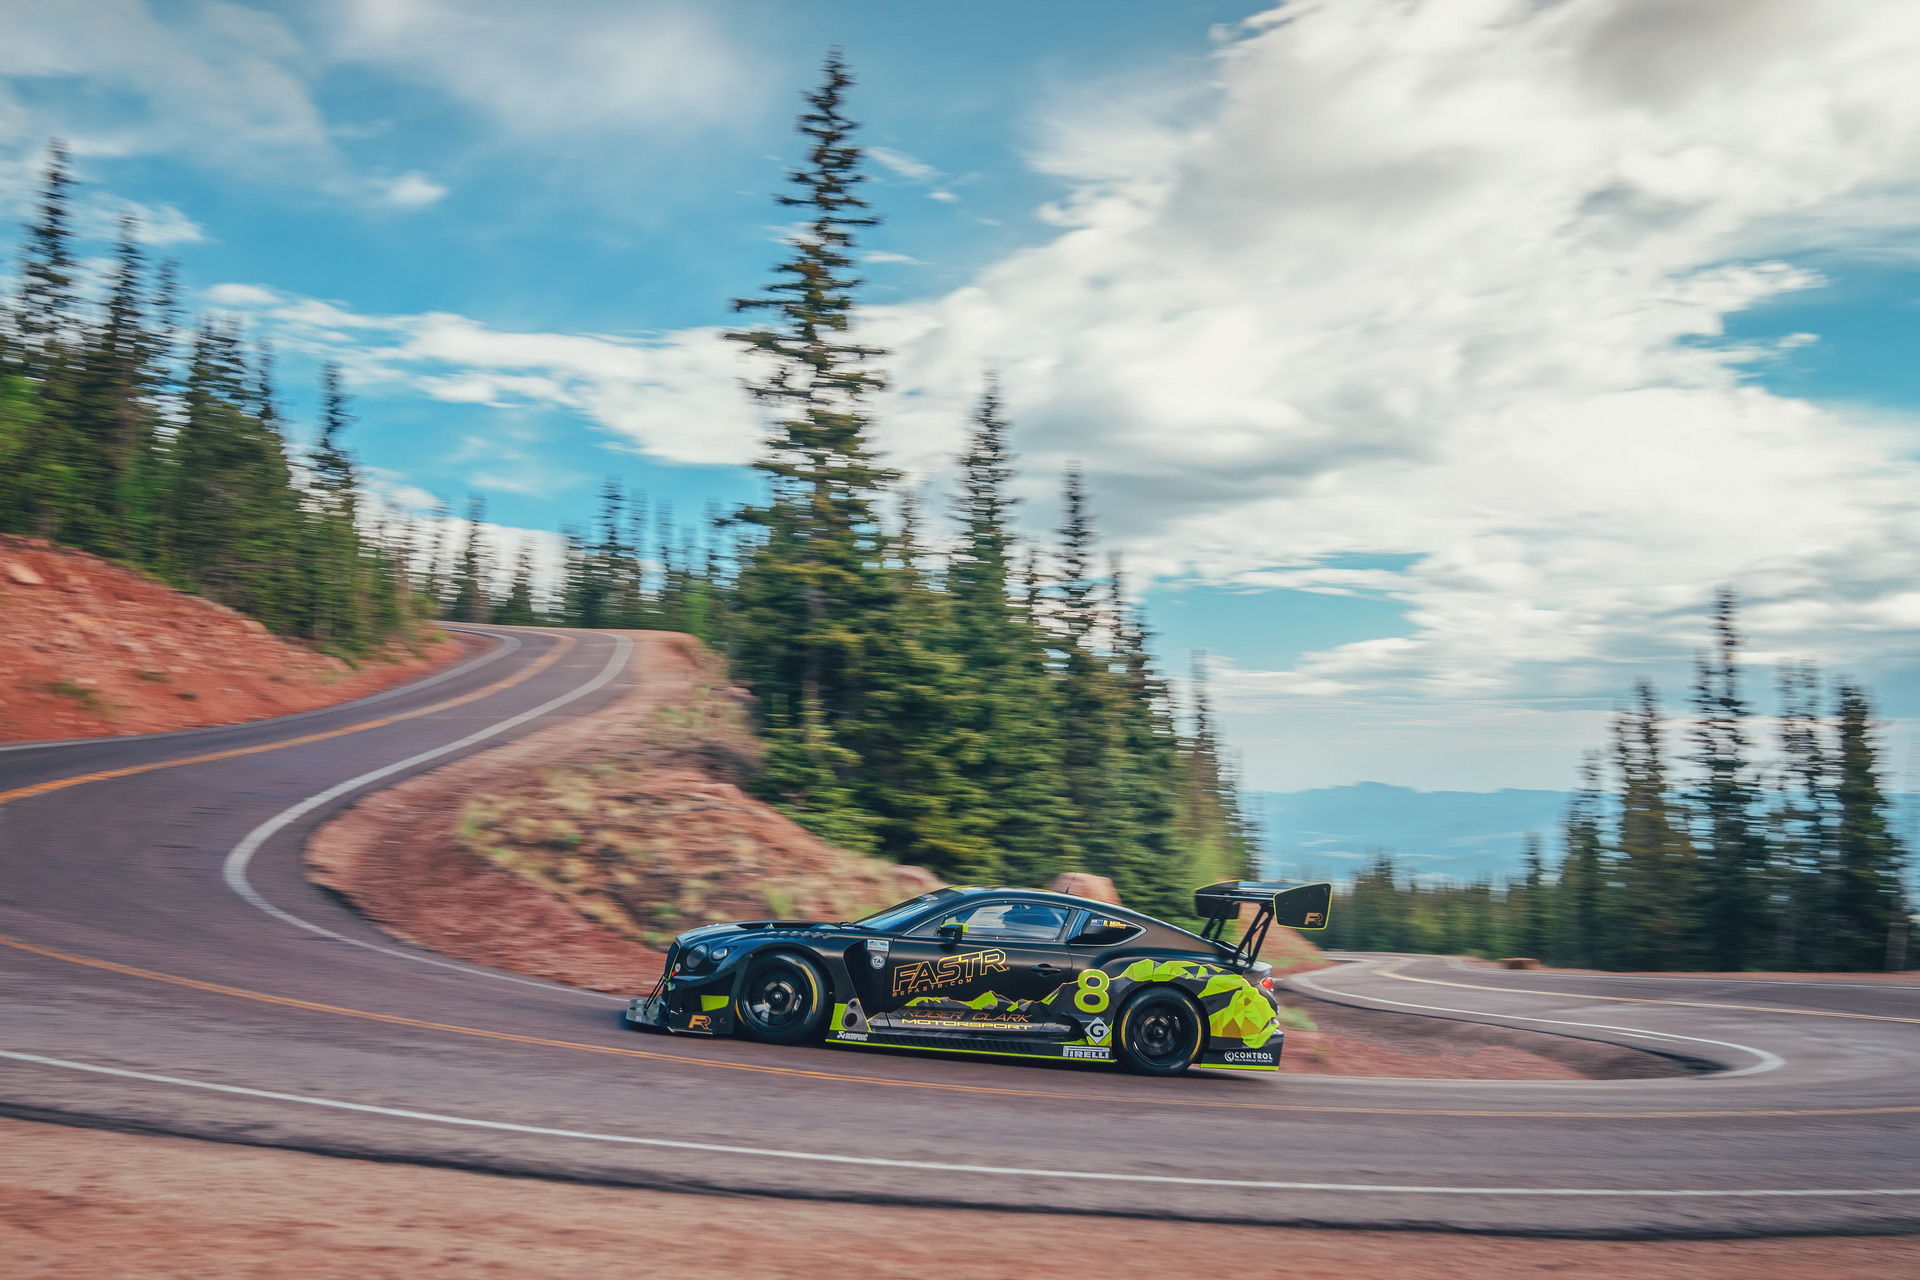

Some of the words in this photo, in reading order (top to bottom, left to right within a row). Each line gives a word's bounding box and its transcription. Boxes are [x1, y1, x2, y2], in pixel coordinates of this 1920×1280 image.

[892, 978, 972, 997] BEFASTR.COM
[1074, 968, 1110, 1014] 8
[903, 1009, 964, 1020] ROGER
[971, 1012, 1032, 1023] CLARK
[901, 1018, 1033, 1030] MOTORSPORT
[1089, 1023, 1104, 1038] G
[1062, 1045, 1110, 1059] PIRELLI
[1234, 1051, 1273, 1061] CONTROL
